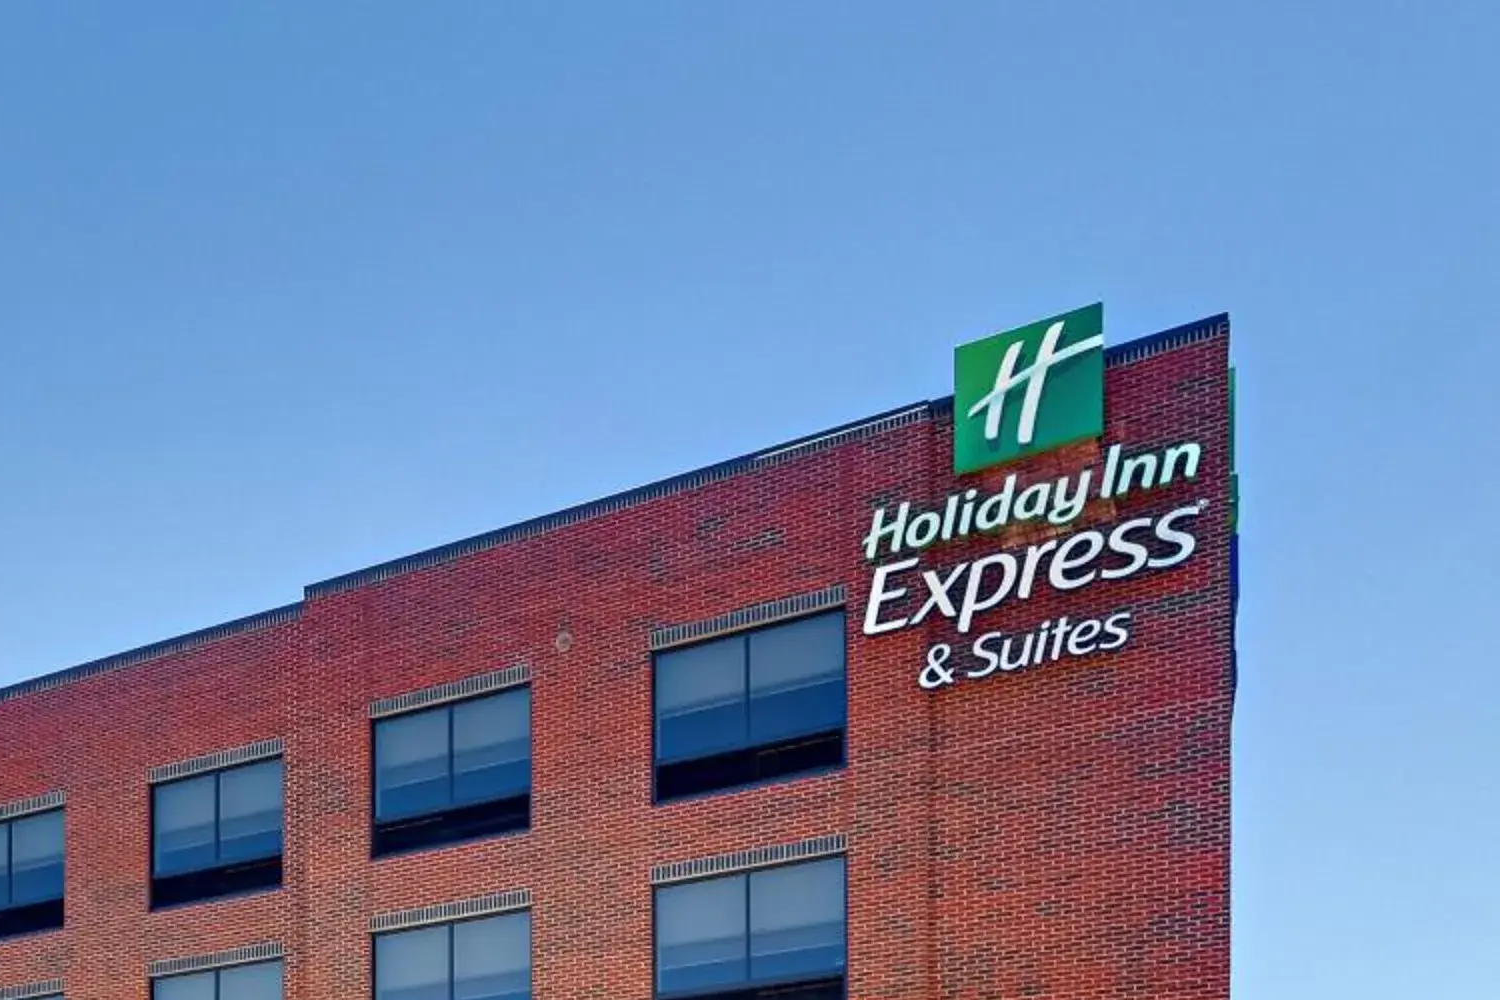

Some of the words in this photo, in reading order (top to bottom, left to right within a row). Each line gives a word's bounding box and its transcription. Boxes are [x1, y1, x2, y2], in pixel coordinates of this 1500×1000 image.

[863, 474, 1092, 559] Holiday
[1101, 442, 1201, 498] Inn
[863, 505, 1200, 635] Express
[918, 643, 954, 689] &
[967, 612, 1131, 677] Suites
